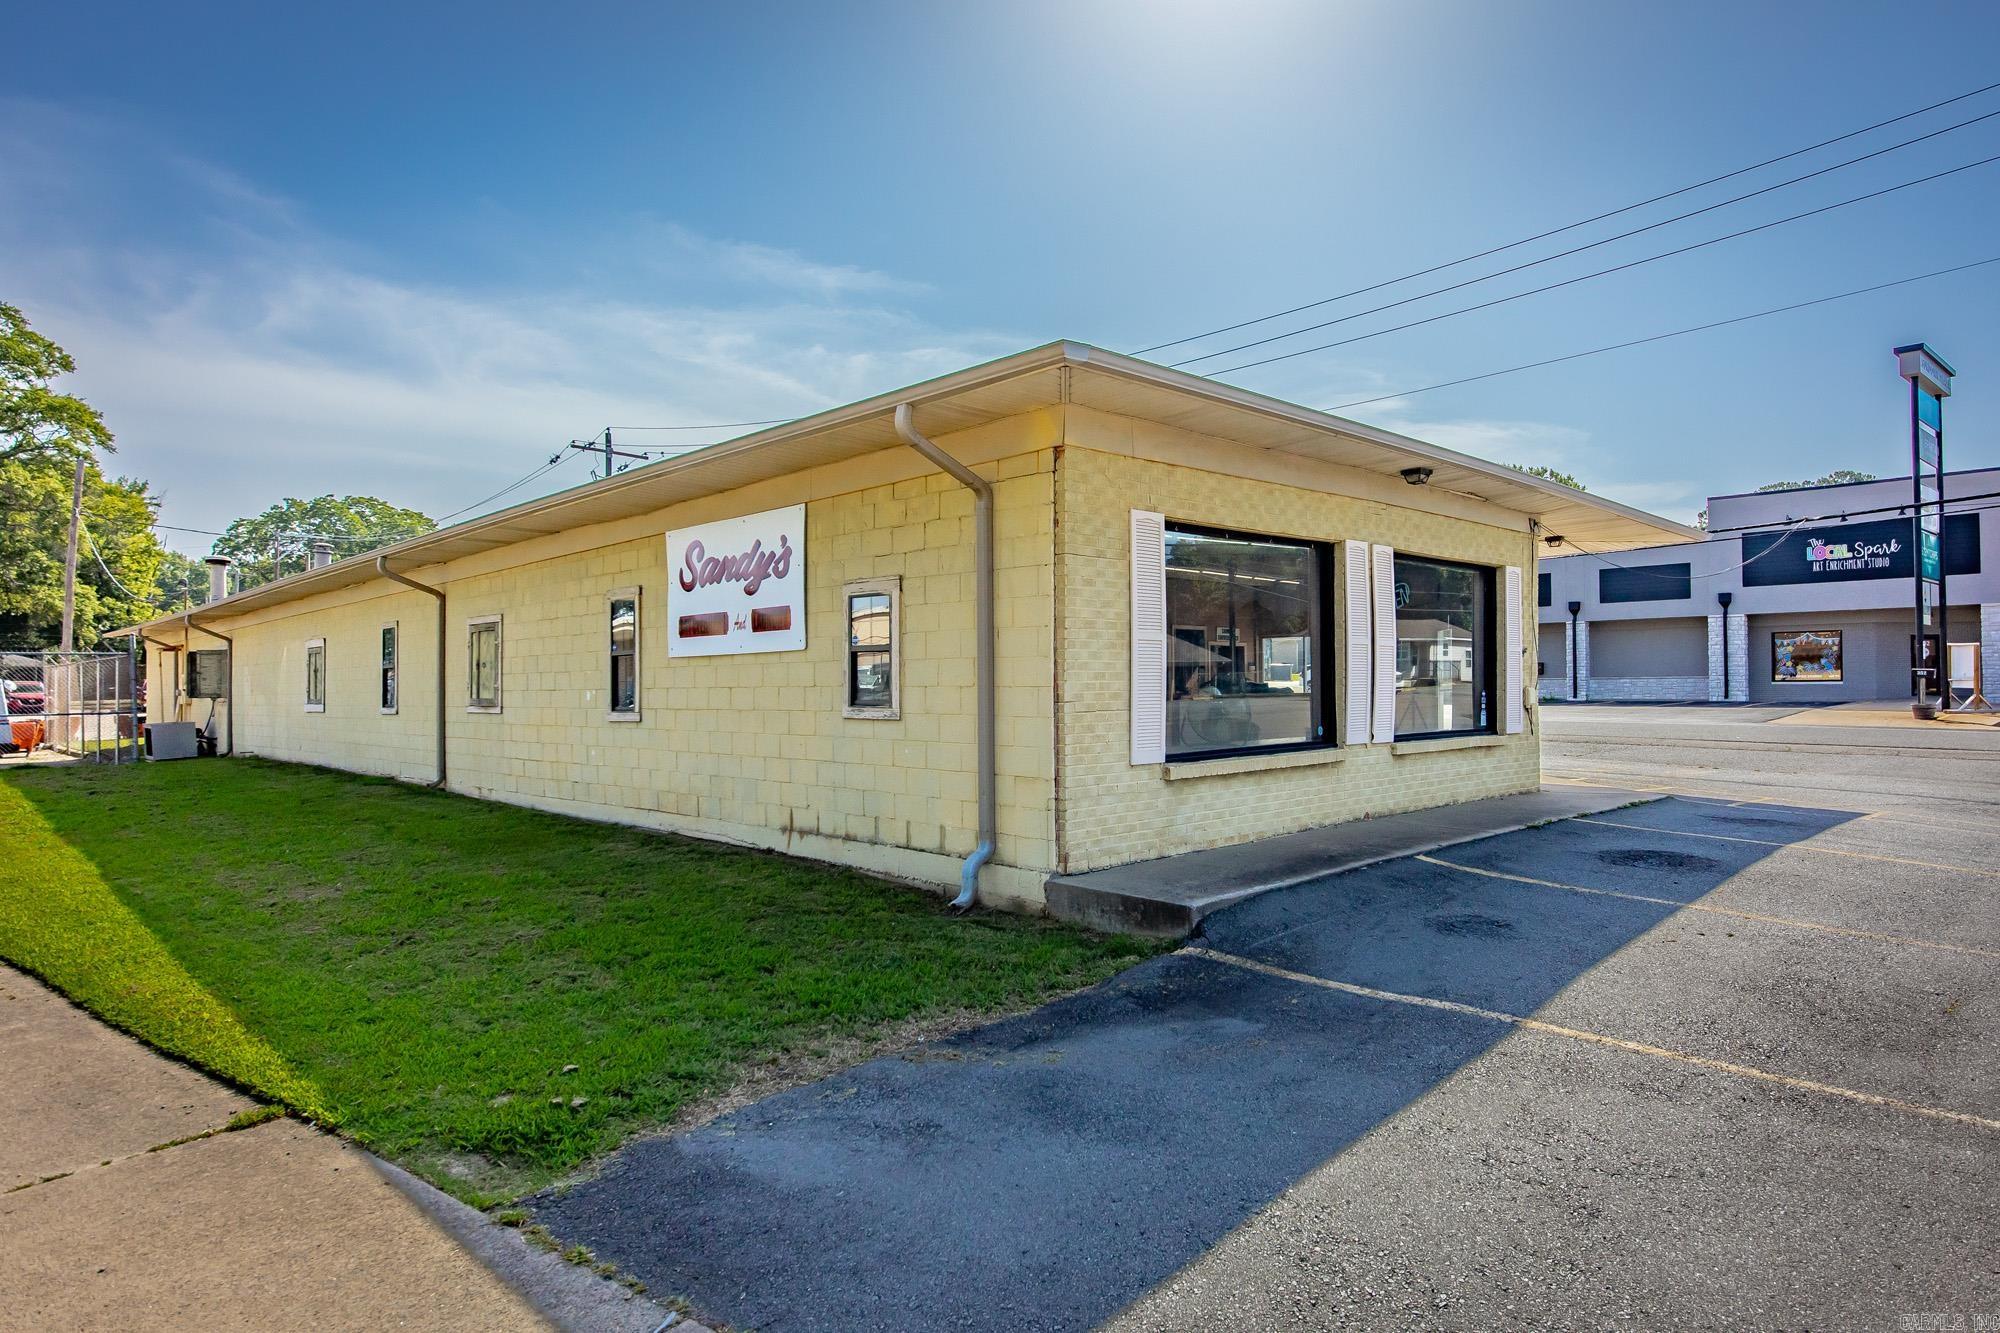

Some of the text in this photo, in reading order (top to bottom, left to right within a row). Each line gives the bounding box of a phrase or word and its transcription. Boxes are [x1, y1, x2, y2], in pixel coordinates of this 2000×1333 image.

[1806, 544, 1853, 561] LOCAL
[1854, 538, 1902, 560] Spark
[1807, 538, 1825, 548] The
[679, 534, 793, 596] Sandy's
[1812, 557, 1890, 572] ART ENRICHMENT STUDIO
